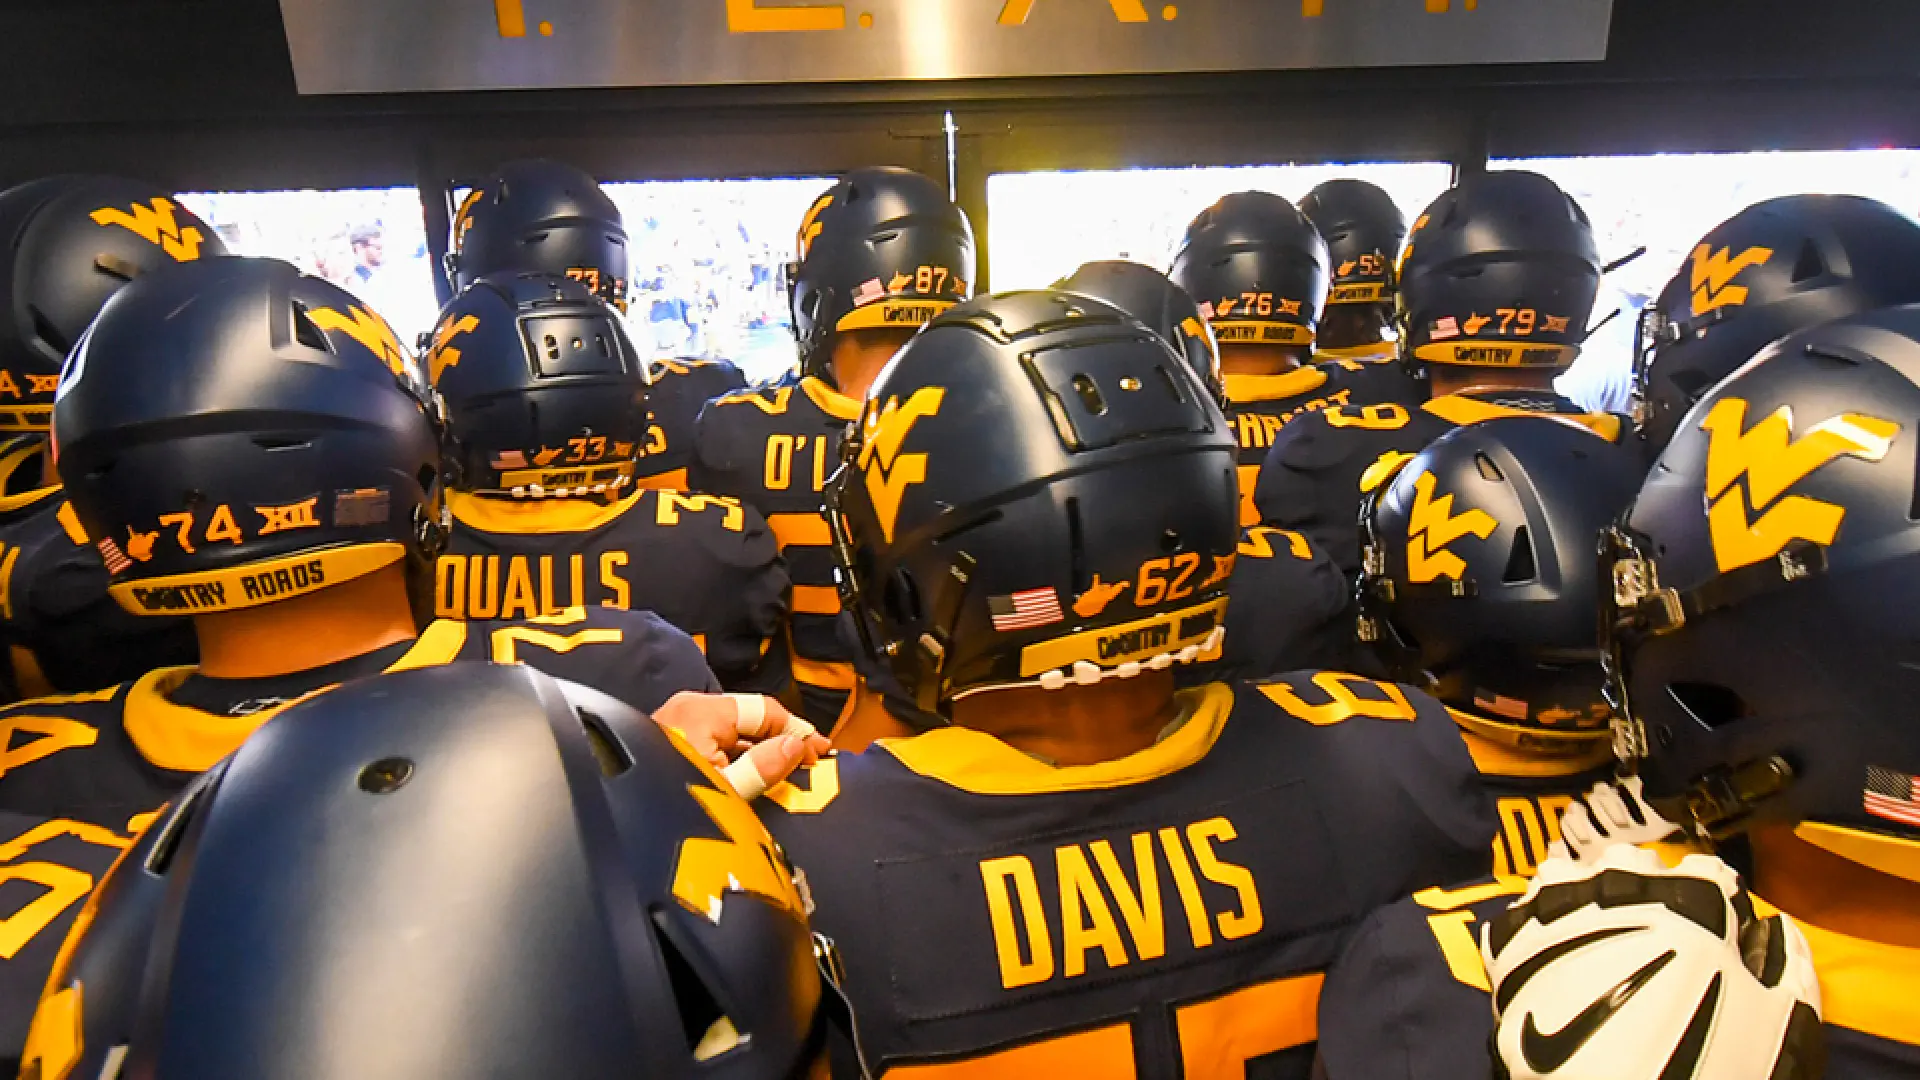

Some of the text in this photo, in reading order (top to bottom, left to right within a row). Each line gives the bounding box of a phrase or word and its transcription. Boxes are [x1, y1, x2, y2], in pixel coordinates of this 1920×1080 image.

[915, 265, 949, 294] 87
[1240, 292, 1273, 316] 76
[1495, 308, 1537, 336] 79
[565, 435, 607, 463] 33
[158, 503, 244, 554] 74
[434, 551, 631, 622] QUALLS
[1134, 551, 1201, 608] 62
[978, 816, 1264, 990] DAVIS
